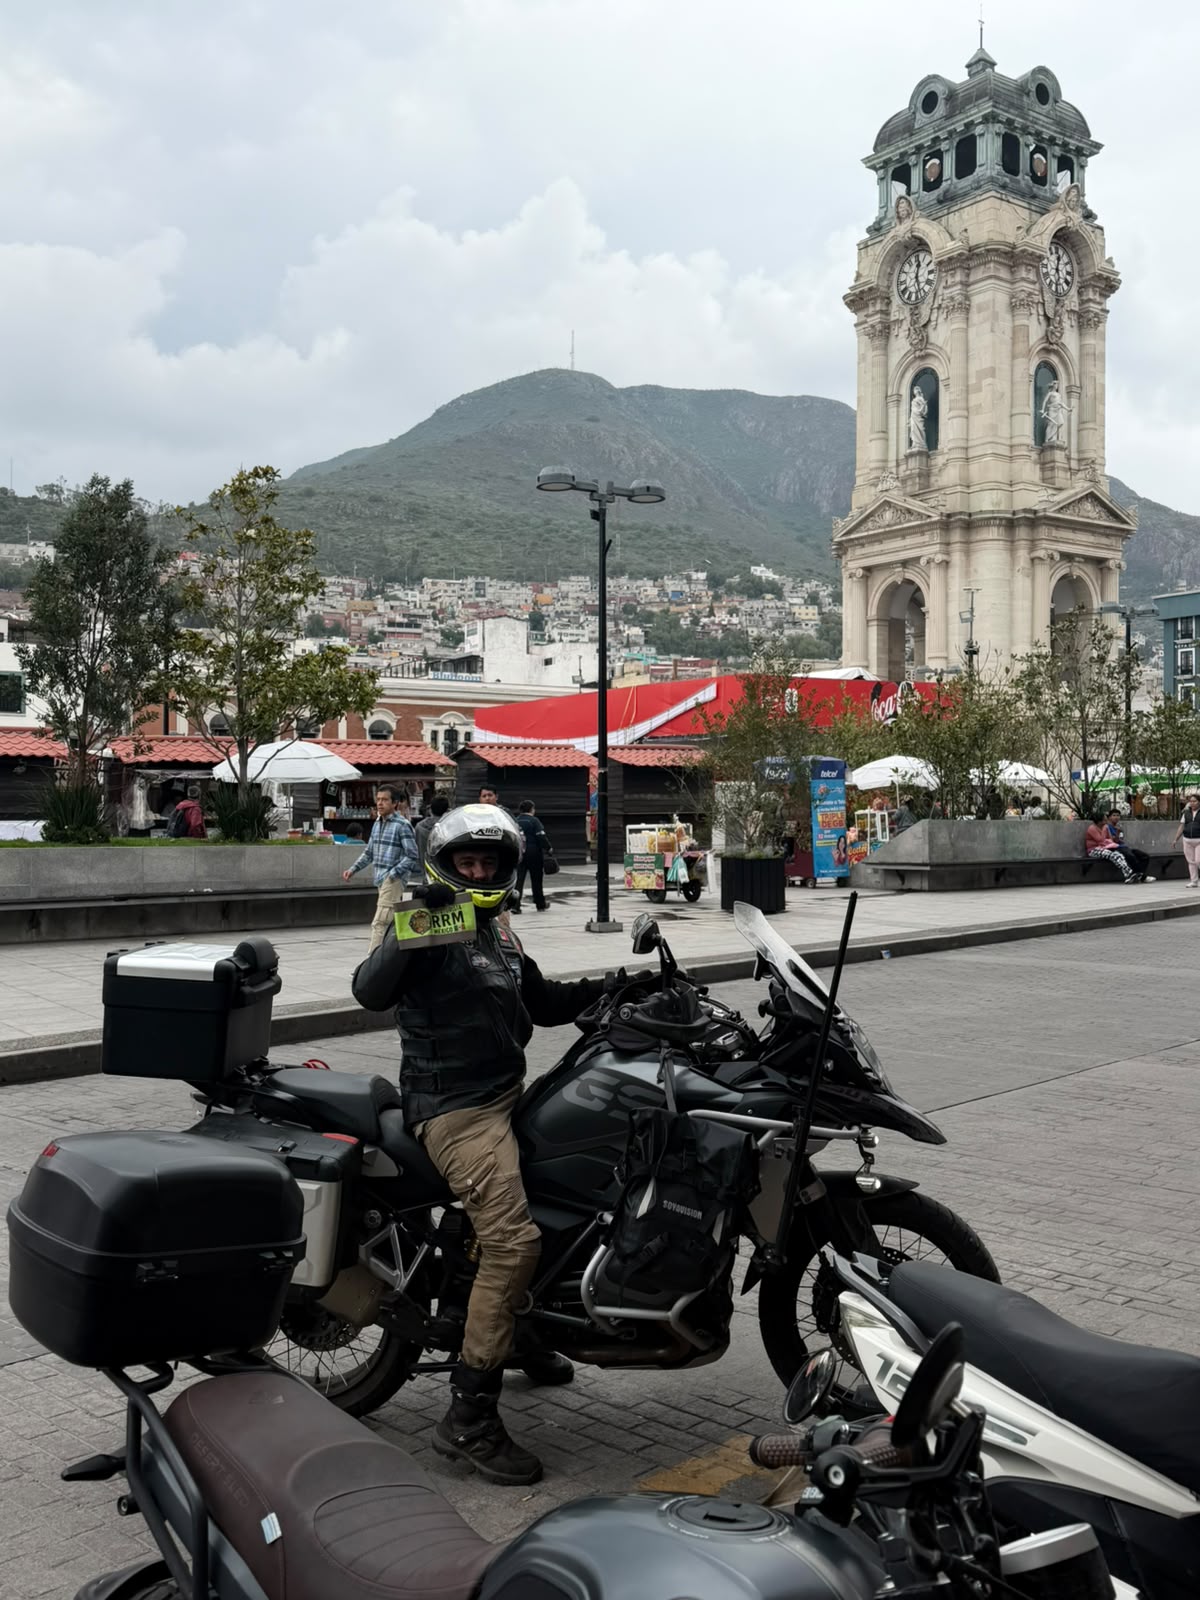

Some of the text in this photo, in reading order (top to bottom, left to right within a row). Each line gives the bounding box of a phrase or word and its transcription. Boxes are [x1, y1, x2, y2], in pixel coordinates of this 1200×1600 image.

[820, 769, 839, 778] telcel
[820, 812, 845, 821] TRIPLE
[821, 820, 832, 828] DE
[431, 910, 465, 928] RRM
